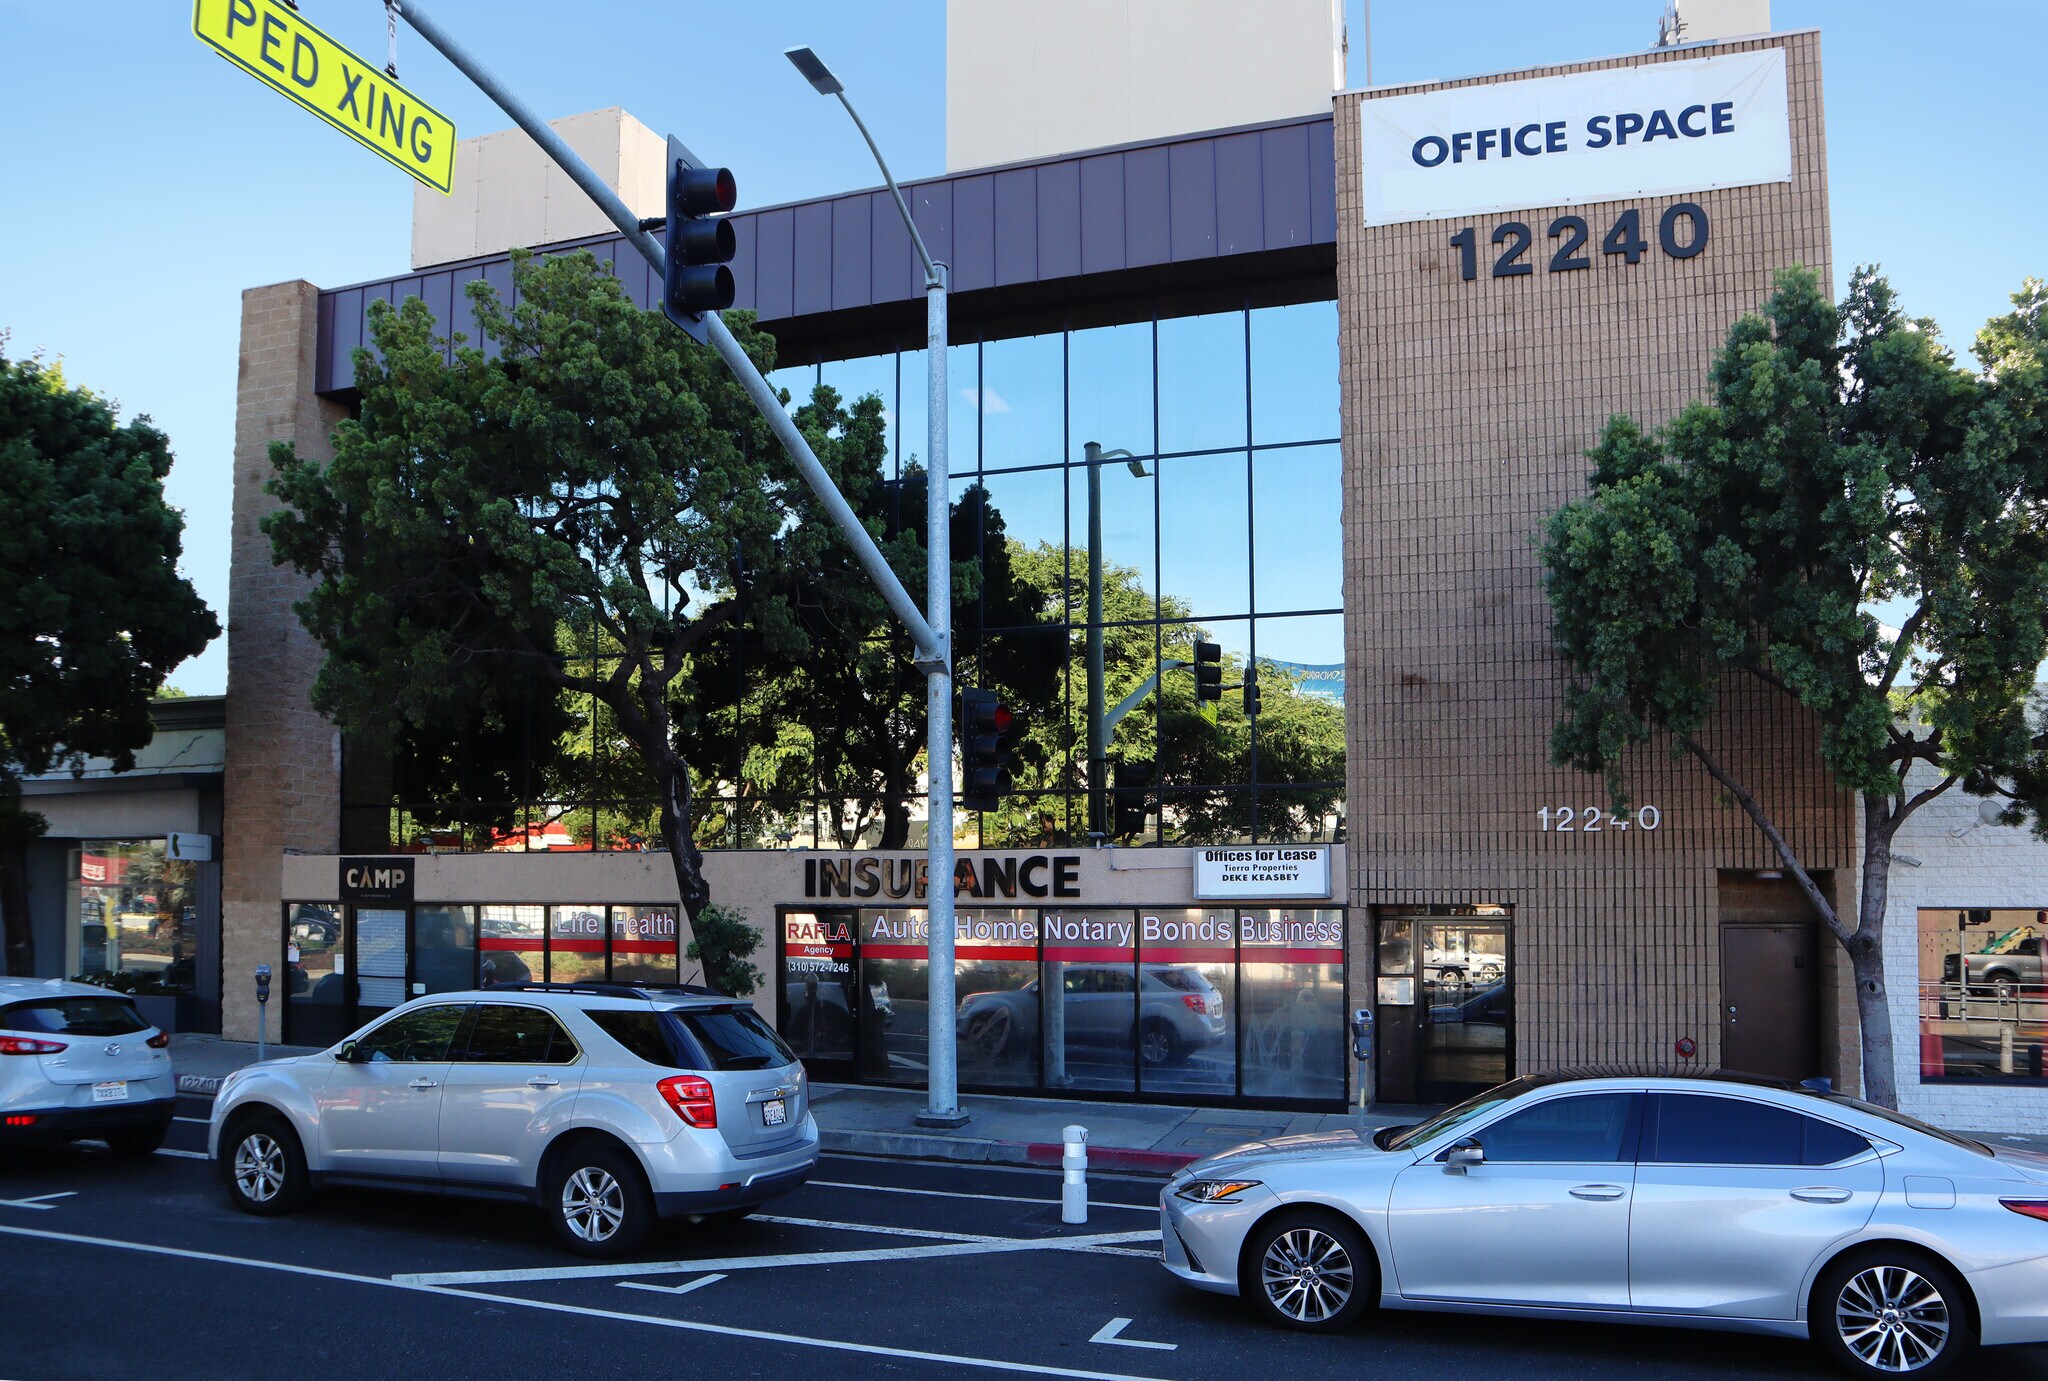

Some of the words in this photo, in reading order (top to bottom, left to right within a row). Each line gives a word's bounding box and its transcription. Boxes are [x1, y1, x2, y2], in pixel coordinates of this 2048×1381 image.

[226, 0, 319, 88] PED
[337, 63, 433, 164] XING
[1411, 120, 1569, 168] OFFICE
[1585, 101, 1735, 149] SPACE
[1449, 202, 1709, 281] 12240
[1537, 805, 1661, 832] 12240
[1205, 850, 1253, 862] Offices
[1256, 850, 1275, 861] for
[1277, 849, 1317, 861] Lease
[346, 866, 406, 889] CAMP
[1222, 874, 1248, 882] DEKE
[1251, 873, 1300, 882] KEASBEY
[1224, 864, 1250, 872] Tierra
[1252, 863, 1298, 873] Properties
[556, 911, 599, 934] Life
[613, 911, 675, 935] Health
[787, 922, 850, 941] RAFLA
[871, 914, 929, 940] Auto
[954, 914, 1036, 940] Home
[1043, 915, 1133, 947] Notary
[1142, 915, 1233, 942] Bonds
[1240, 915, 1343, 942] Business
[803, 945, 834, 955] Agency
